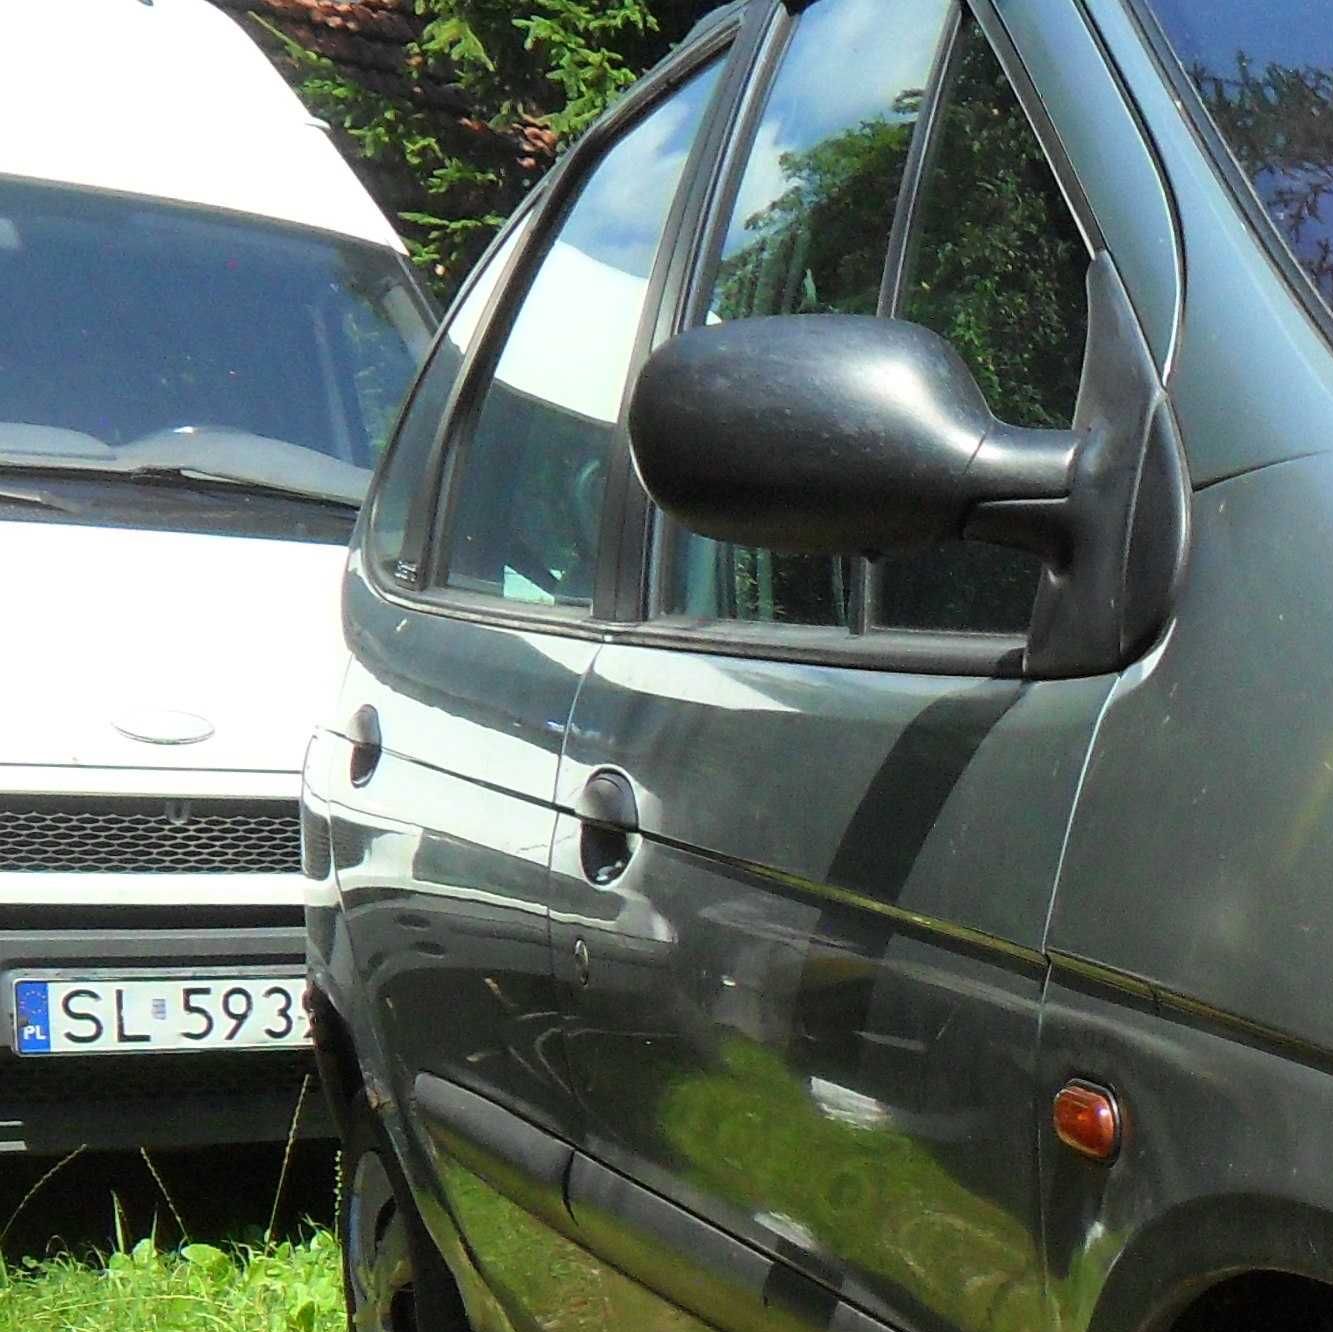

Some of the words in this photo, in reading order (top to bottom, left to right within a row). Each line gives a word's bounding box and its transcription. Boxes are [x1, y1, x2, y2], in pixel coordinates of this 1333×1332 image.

[23, 1025, 46, 1040] PL
[61, 988, 151, 1044] SL
[180, 986, 313, 1042] 593
